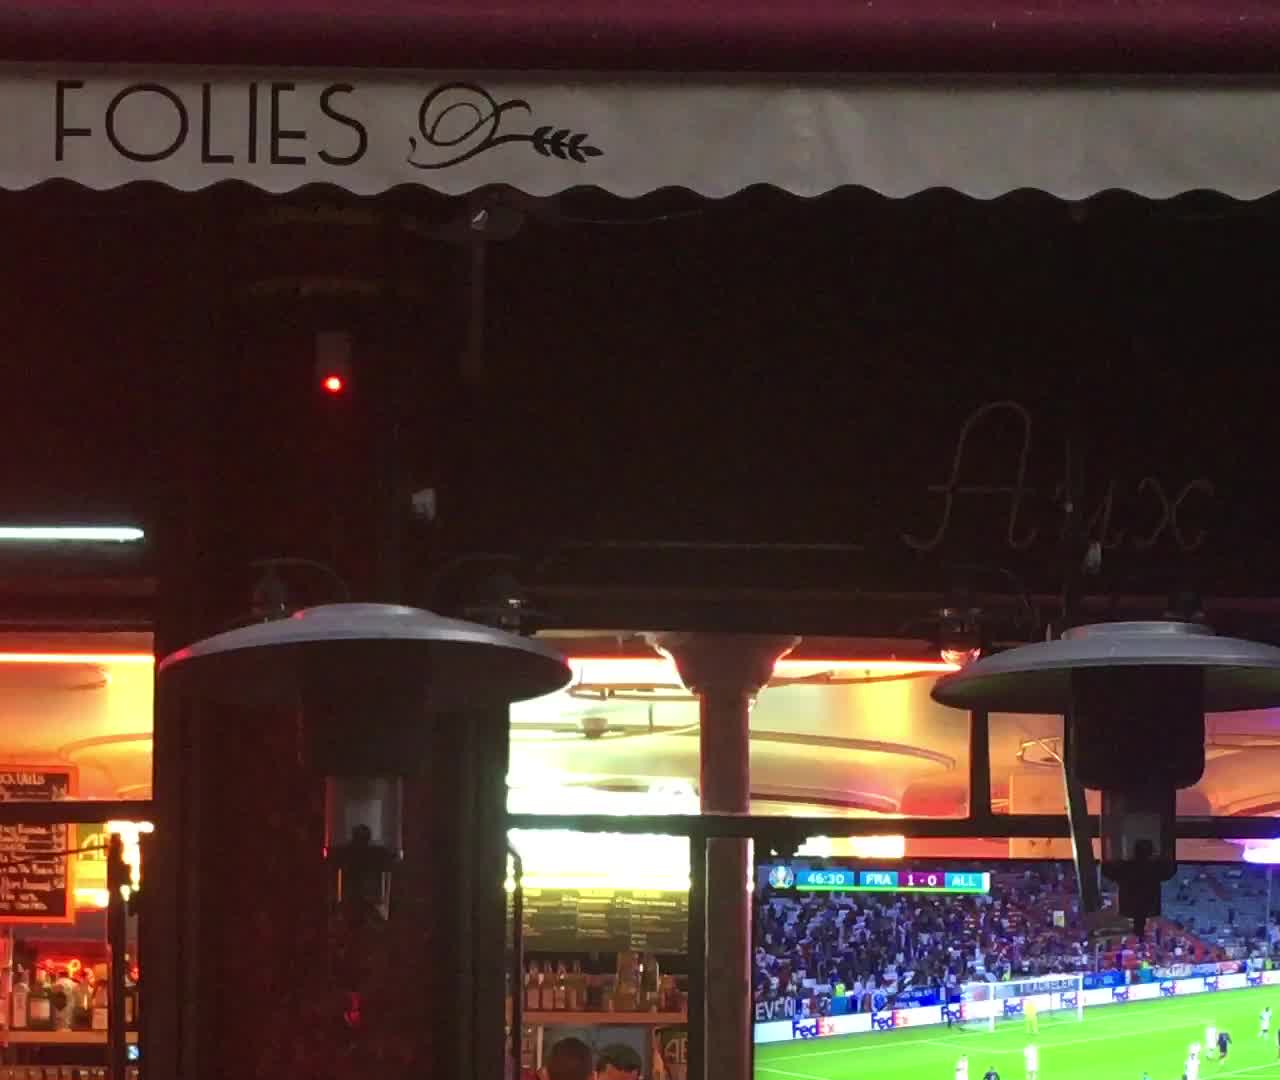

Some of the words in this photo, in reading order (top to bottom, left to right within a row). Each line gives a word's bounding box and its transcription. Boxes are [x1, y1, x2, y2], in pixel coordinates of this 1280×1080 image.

[55, 82, 369, 166] FOLIES
[865, 874, 892, 886] FRA
[951, 874, 976, 887] ALL
[791, 1016, 835, 1038] FedEx
